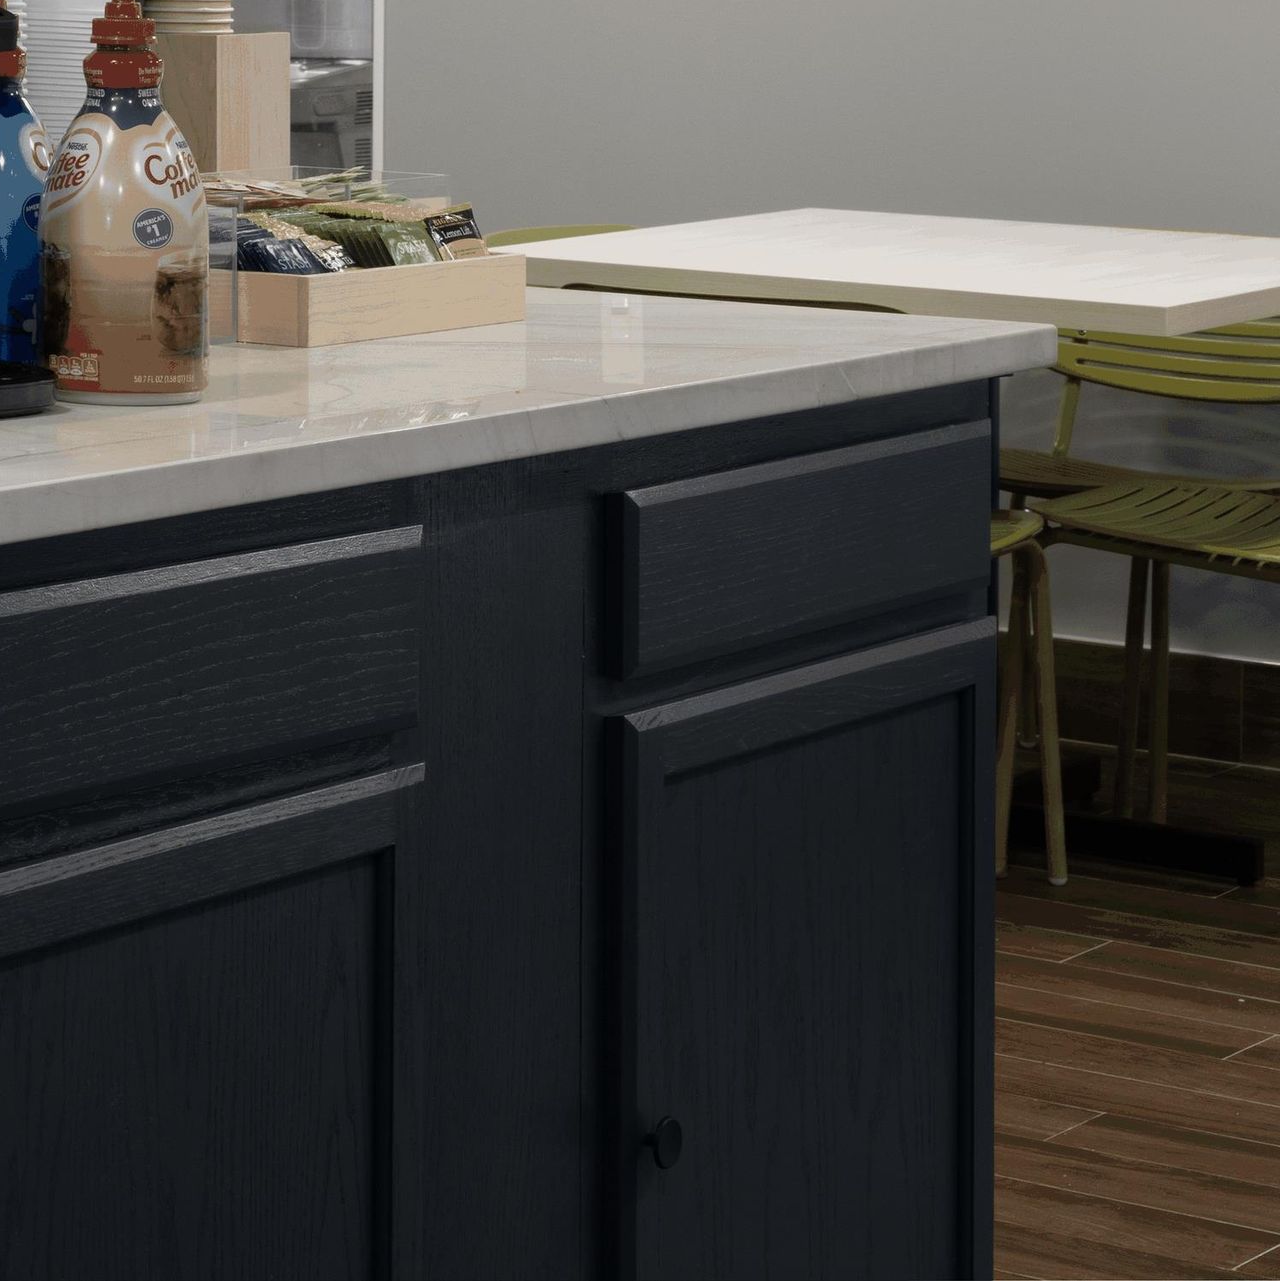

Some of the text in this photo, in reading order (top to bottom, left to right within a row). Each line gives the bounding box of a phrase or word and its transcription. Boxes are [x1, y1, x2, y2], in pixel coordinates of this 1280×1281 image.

[54, 152, 90, 176] ffee
[144, 150, 196, 186] Coffe
[136, 214, 166, 228] AMERICA'S
[146, 224, 160, 237] #1
[279, 255, 312, 270] STASH
